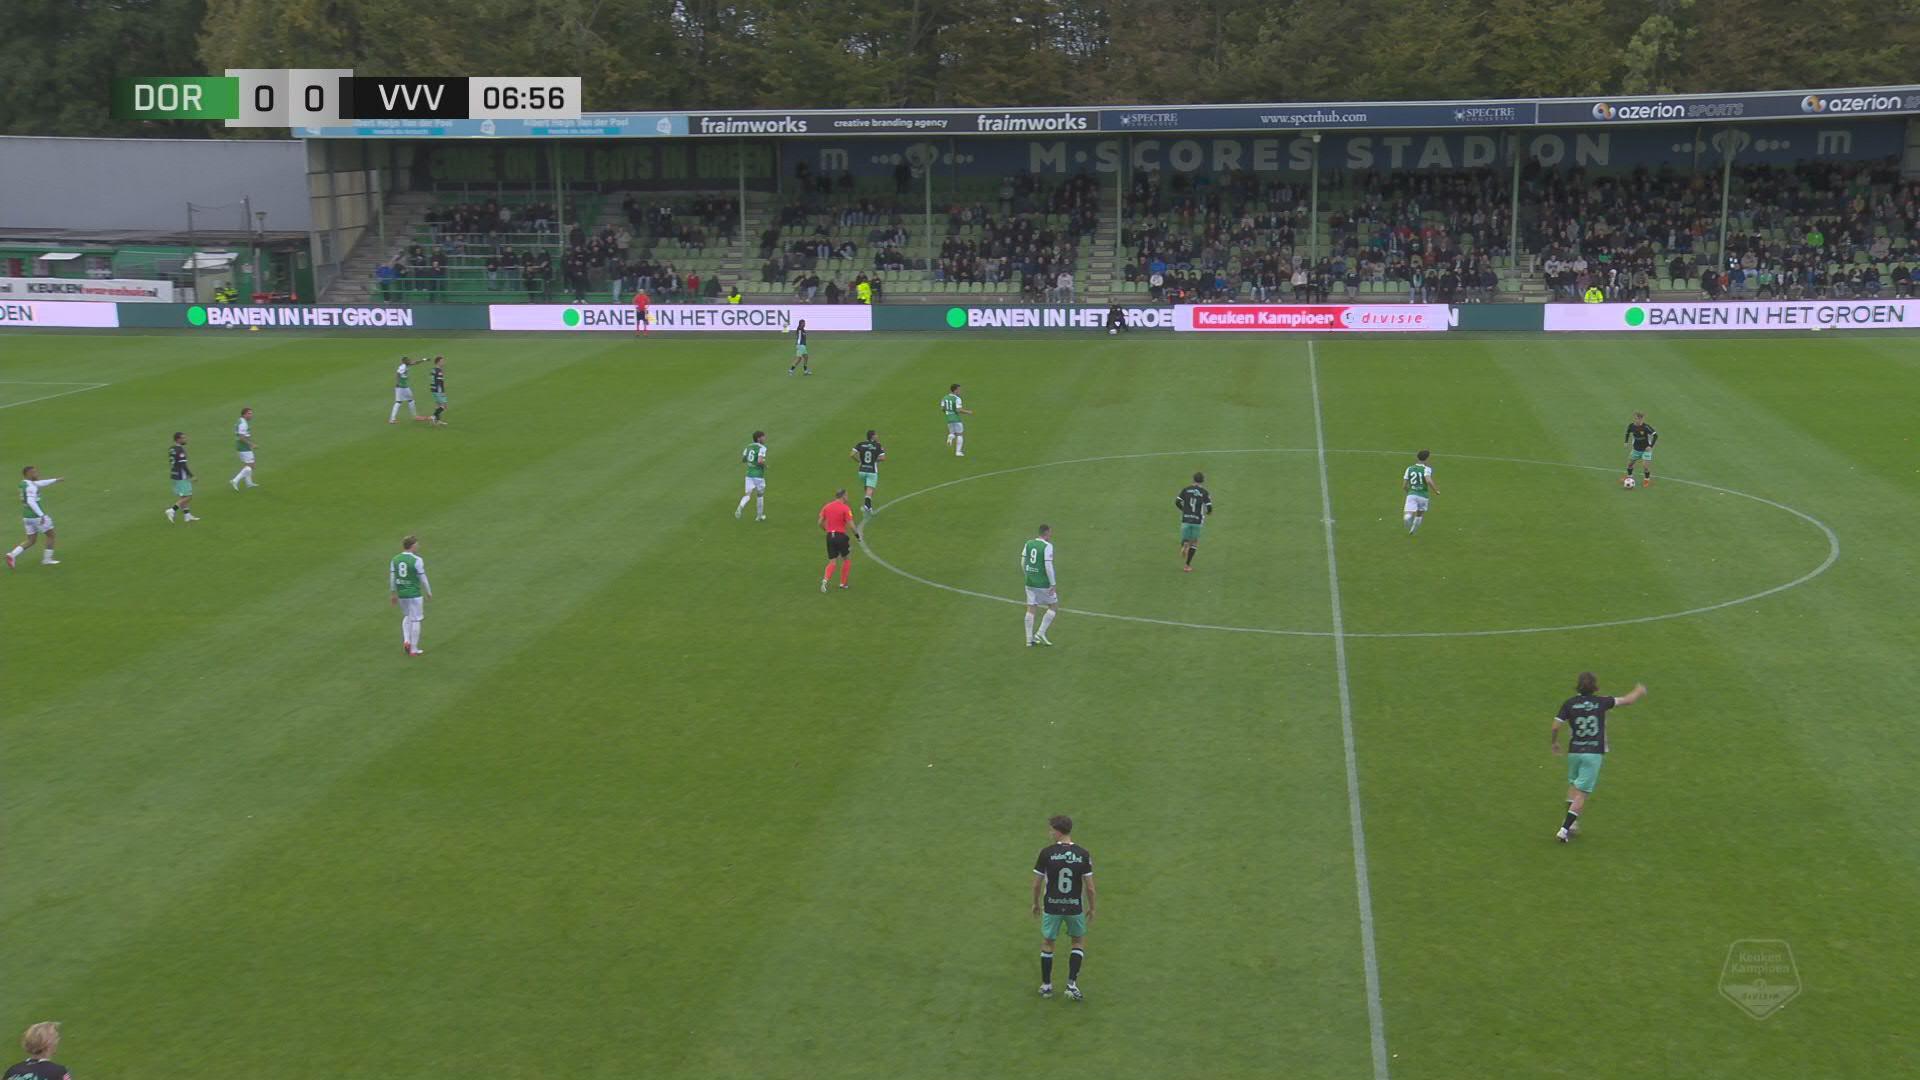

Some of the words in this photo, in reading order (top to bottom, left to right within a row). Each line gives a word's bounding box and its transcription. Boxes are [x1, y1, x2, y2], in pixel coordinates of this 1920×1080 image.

[1618, 102, 1685, 119] azerion
[1687, 103, 1744, 117] SPORTS
[1828, 94, 1902, 111] azerion
[1131, 111, 1178, 122] SPECTRE
[1260, 111, 1367, 126] www.spctrhub.com
[1465, 107, 1515, 118] SPECTRE
[700, 116, 808, 133] fraimworks
[833, 118, 870, 128] creative
[871, 117, 914, 129] branding
[914, 119, 948, 129] agency
[977, 114, 1088, 132] fraimworks
[207, 307, 276, 326] BANEN
[278, 308, 300, 325] IN
[303, 308, 342, 326] HET
[342, 308, 412, 326] GROEN
[655, 310, 675, 325] IN
[680, 310, 719, 325] HET
[721, 310, 790, 326] GROEN
[968, 308, 1040, 327] BANEN
[1043, 309, 1067, 326] IN
[1069, 309, 1111, 327] HET
[1199, 307, 1255, 325] Keuken
[1257, 305, 1335, 327] Kampioen
[1360, 312, 1425, 324] divisie
[1650, 307, 1729, 325] BANEN
[1736, 308, 1760, 325] IN
[1766, 307, 1813, 324] HET
[1817, 305, 1905, 324] GROEN
[747, 449, 755, 462] 6
[864, 450, 872, 464] 8
[1410, 471, 1424, 485] 21
[1190, 497, 1197, 513] 4
[1029, 547, 1038, 564] 9
[398, 561, 408, 578] 8
[1574, 715, 1600, 738] 33
[1057, 867, 1073, 894] 6
